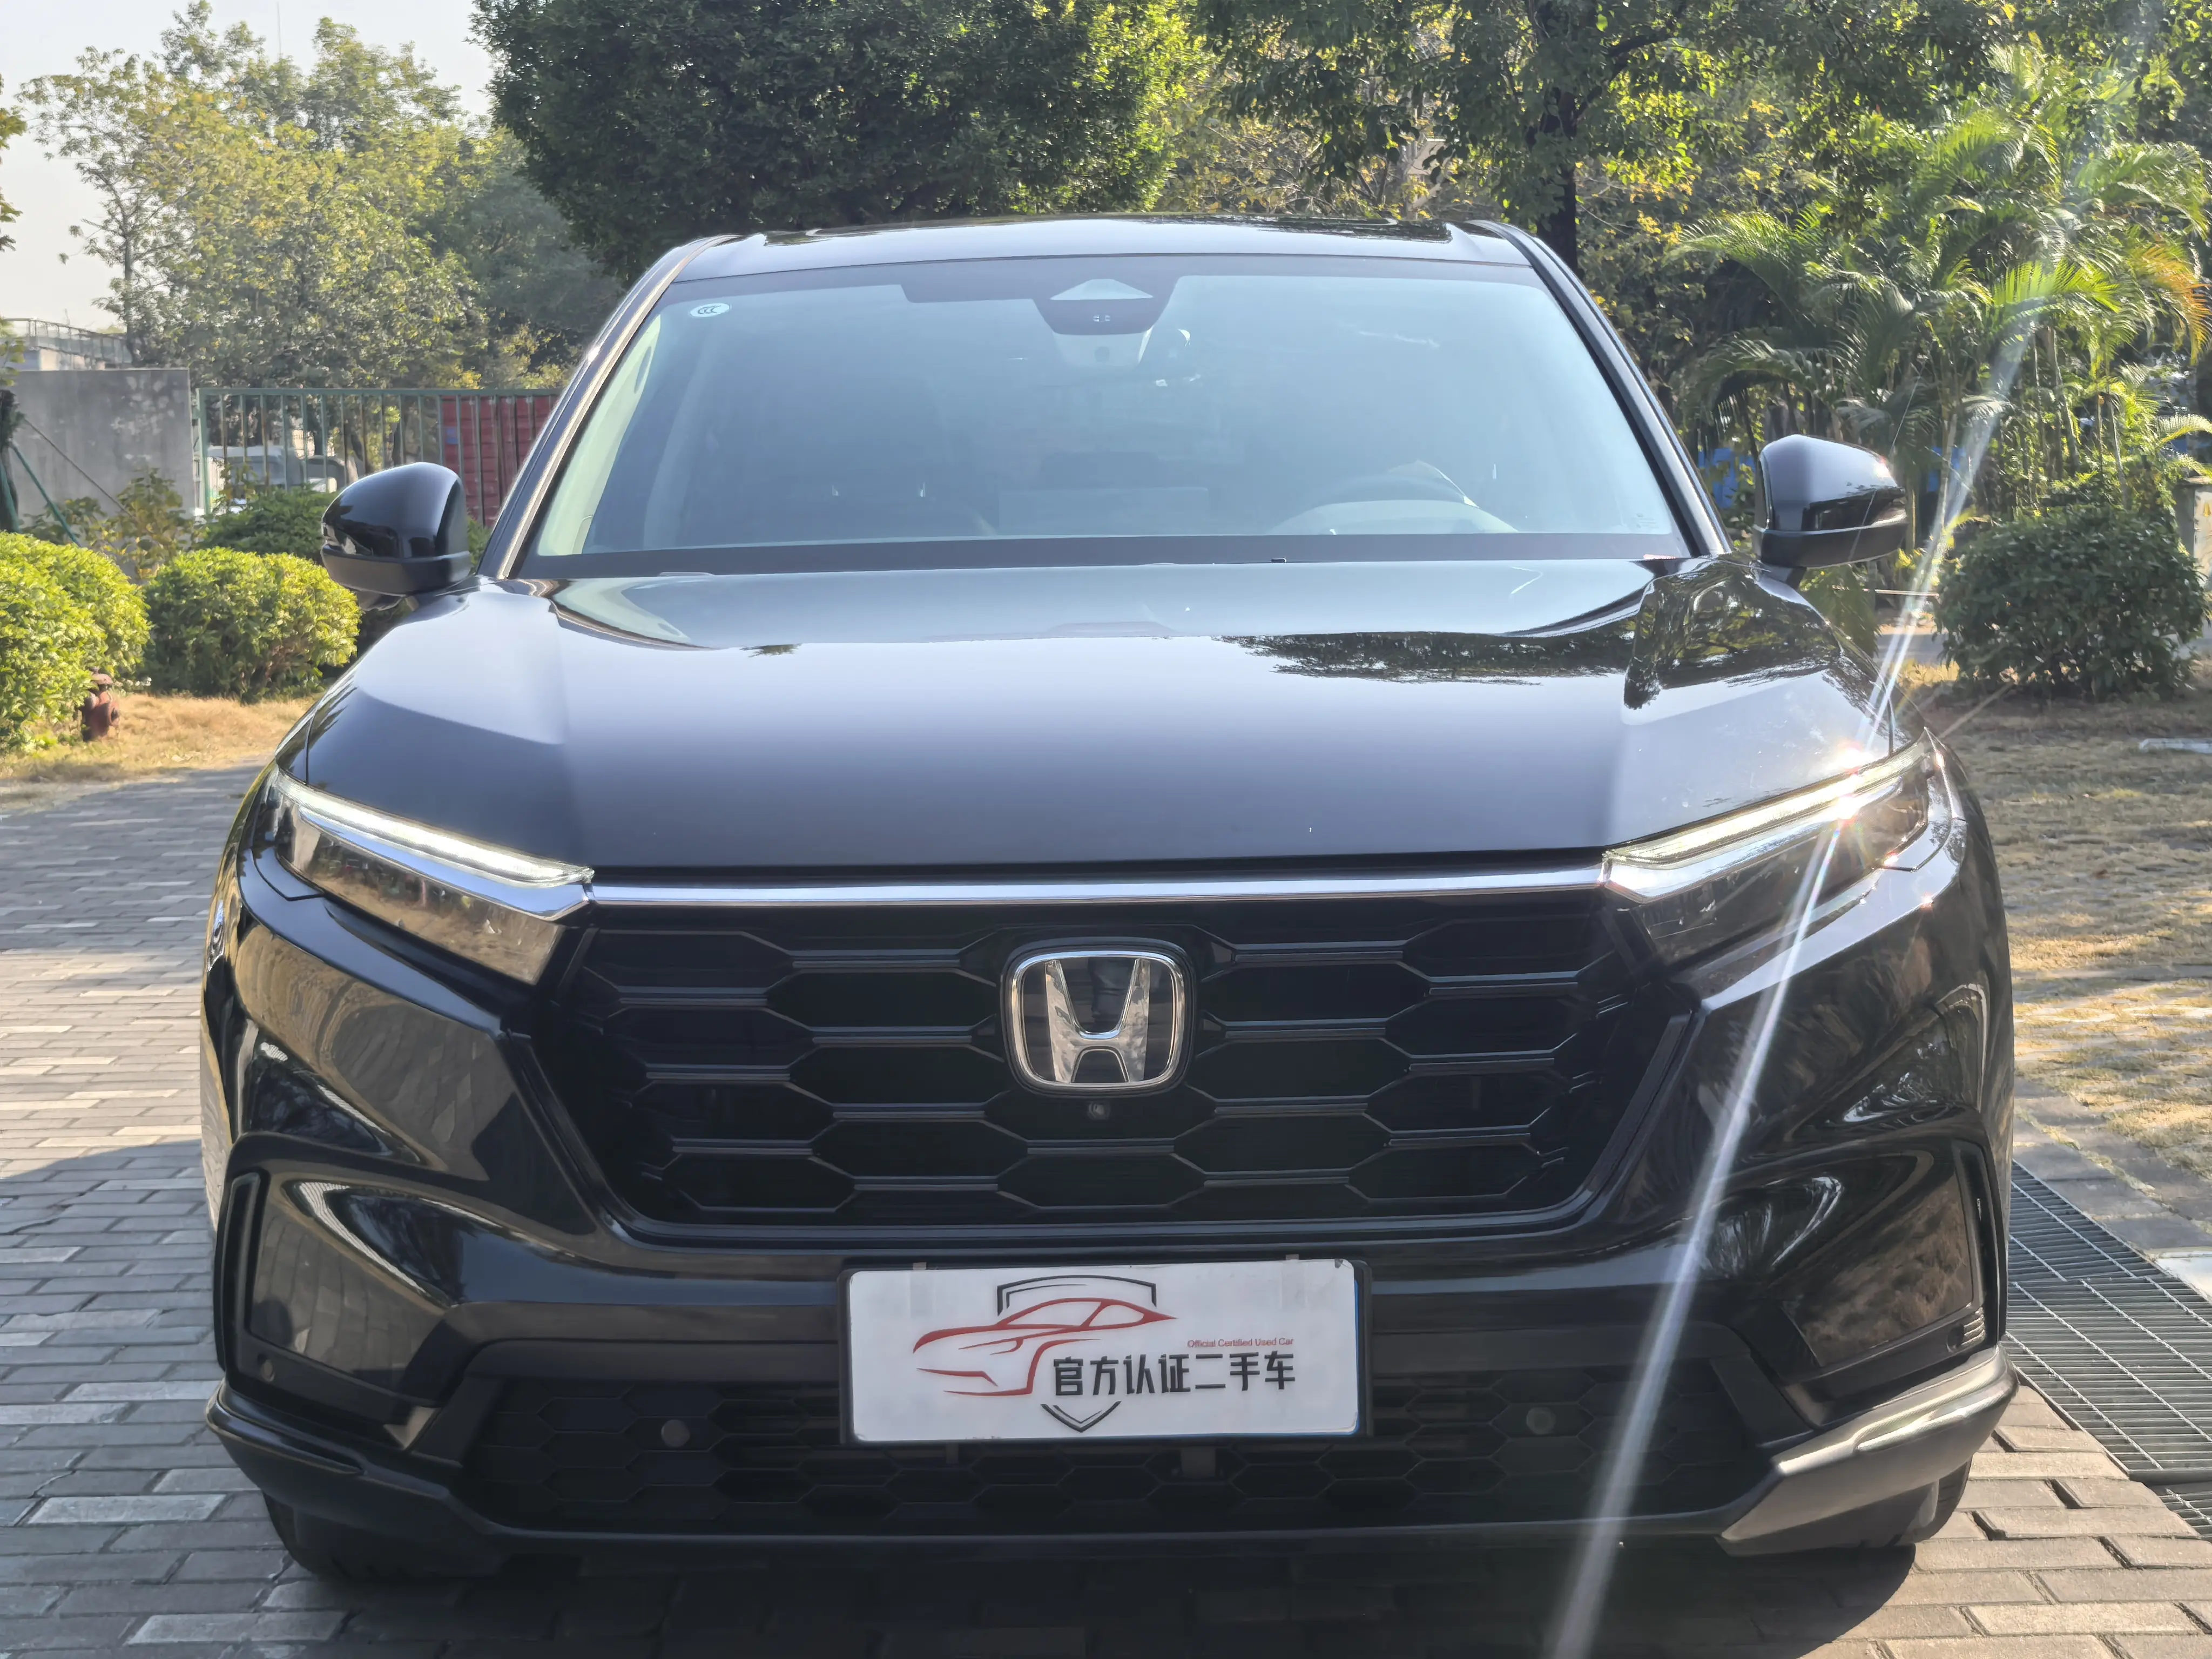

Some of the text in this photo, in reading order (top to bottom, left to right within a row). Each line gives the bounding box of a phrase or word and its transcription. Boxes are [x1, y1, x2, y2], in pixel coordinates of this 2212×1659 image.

[1188, 1337, 1294, 1348] Official Certified Used Car
[1053, 1351, 1296, 1396] 官方认证二手车
